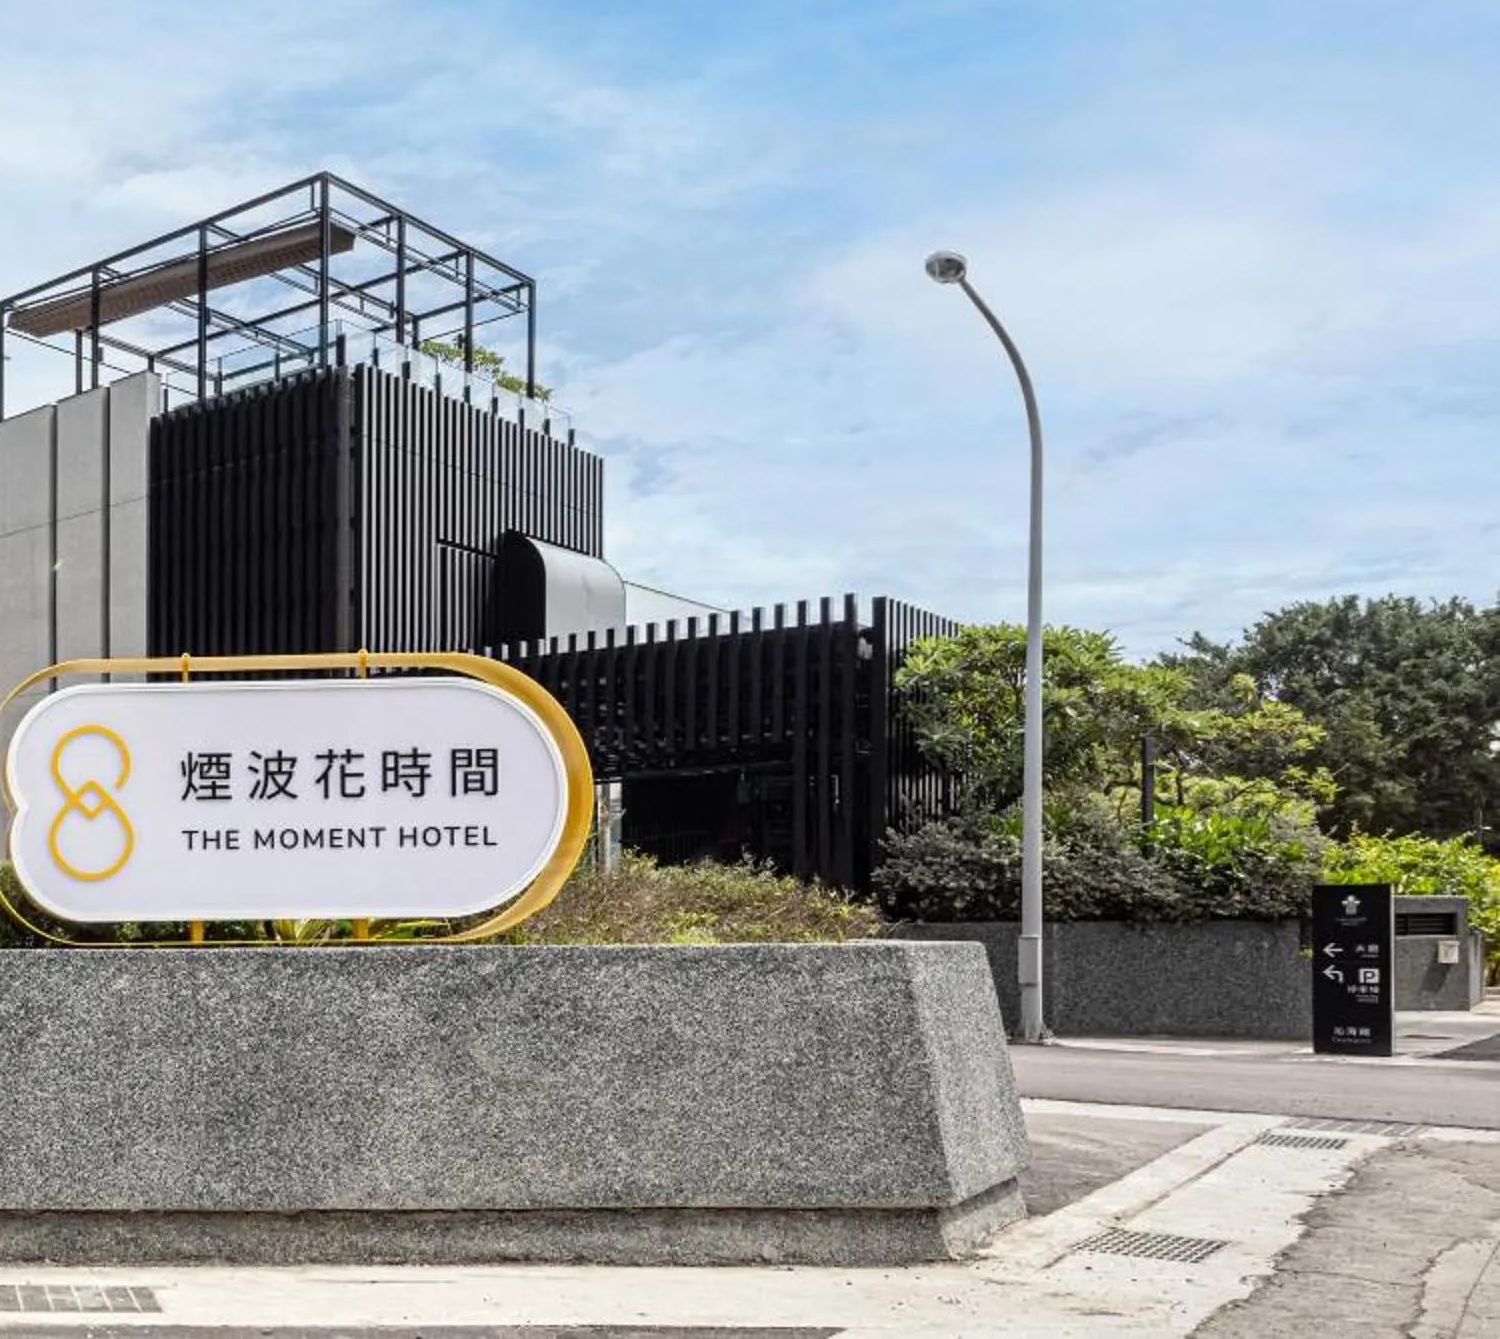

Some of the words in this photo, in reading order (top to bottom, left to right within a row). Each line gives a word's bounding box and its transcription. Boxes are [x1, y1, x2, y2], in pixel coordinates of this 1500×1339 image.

[180, 746, 499, 801] 煙波花時間
[181, 828, 241, 851] THE
[253, 826, 387, 850] MOMENT
[398, 825, 498, 848] HOTEL
